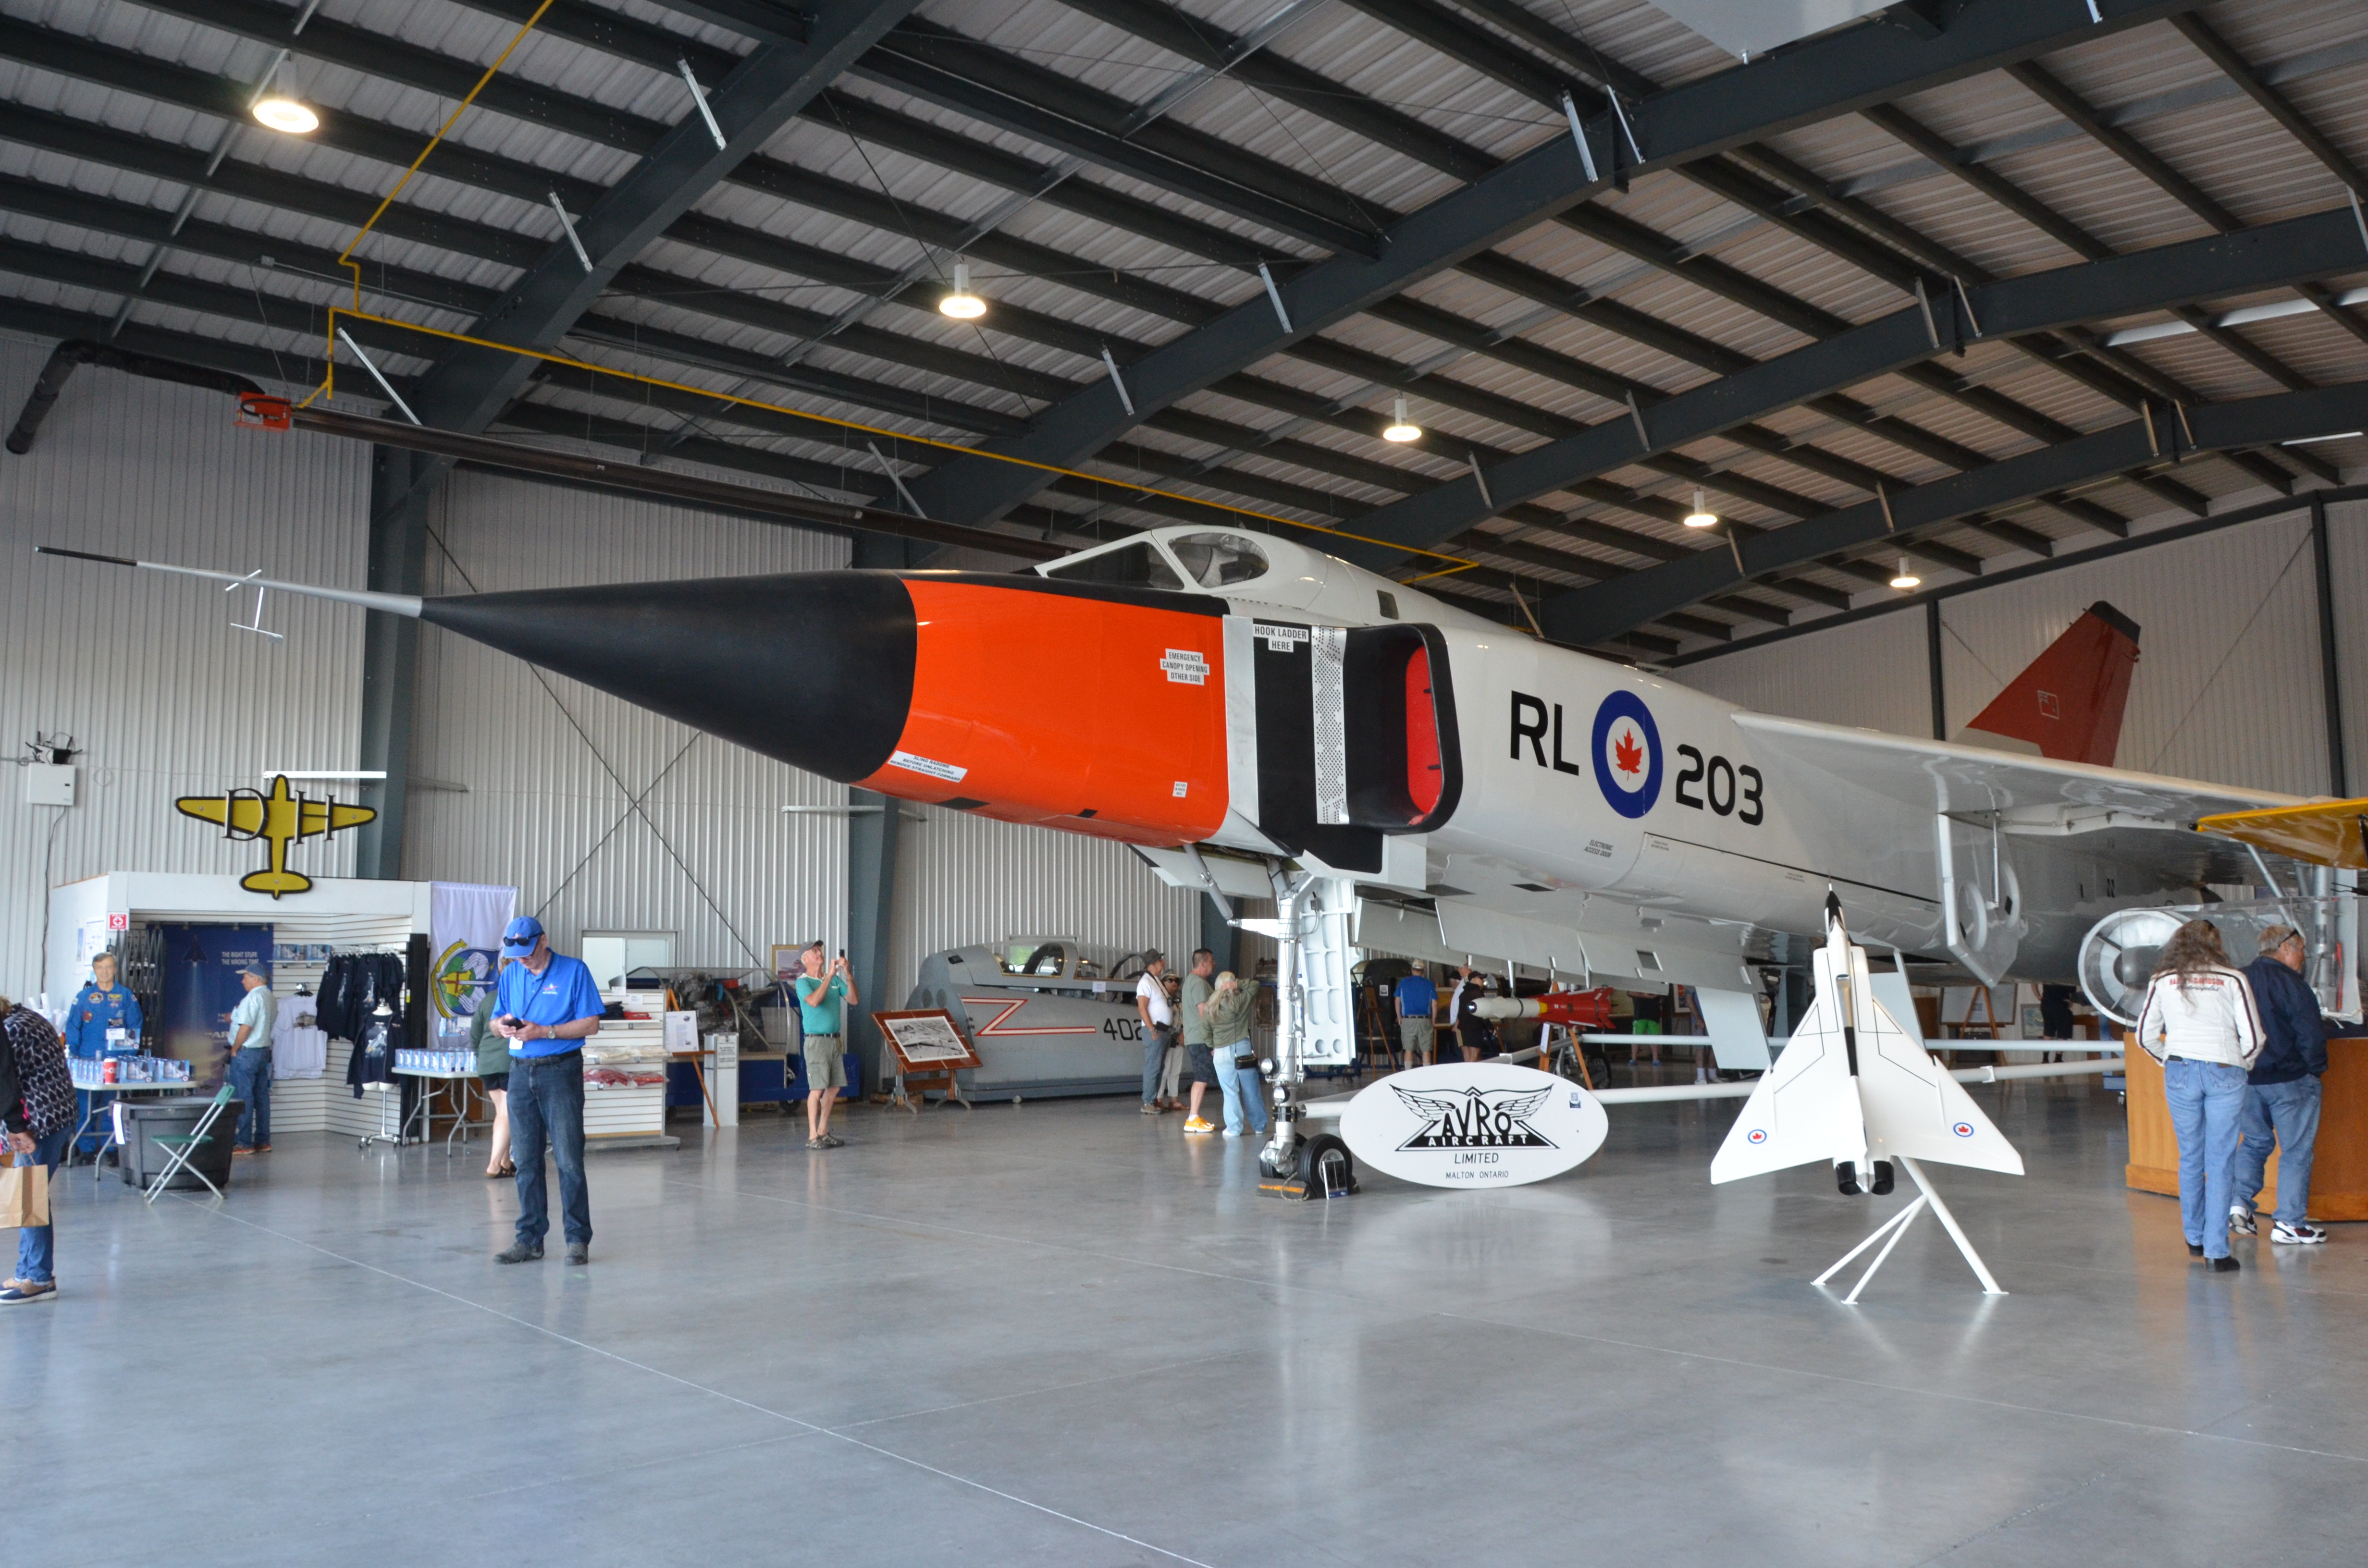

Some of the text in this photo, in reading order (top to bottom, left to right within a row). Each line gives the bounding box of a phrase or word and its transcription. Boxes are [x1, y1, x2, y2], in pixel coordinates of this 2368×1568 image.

[1255, 625, 1307, 639] HOOK LADDER
[1272, 640, 1290, 650] HERE
[1169, 652, 1200, 662] EMERGENCY
[1162, 661, 1208, 673] CANOPY OPENING
[1171, 672, 1188, 680] OTHER
[929, 759, 950, 768] RADOME
[1510, 690, 1764, 825] RL 203
[889, 760, 961, 781] REMOVE STRAIGHT FORWARD
[902, 758, 954, 774] BEFORE UNLATCHING
[1583, 846, 1600, 855] ACCESS
[1103, 1018, 1142, 1041] 402
[1442, 1097, 1512, 1136] AVRO
[1429, 1135, 1527, 1146] AIRCRAFT
[1455, 1152, 1499, 1164] LIMITED
